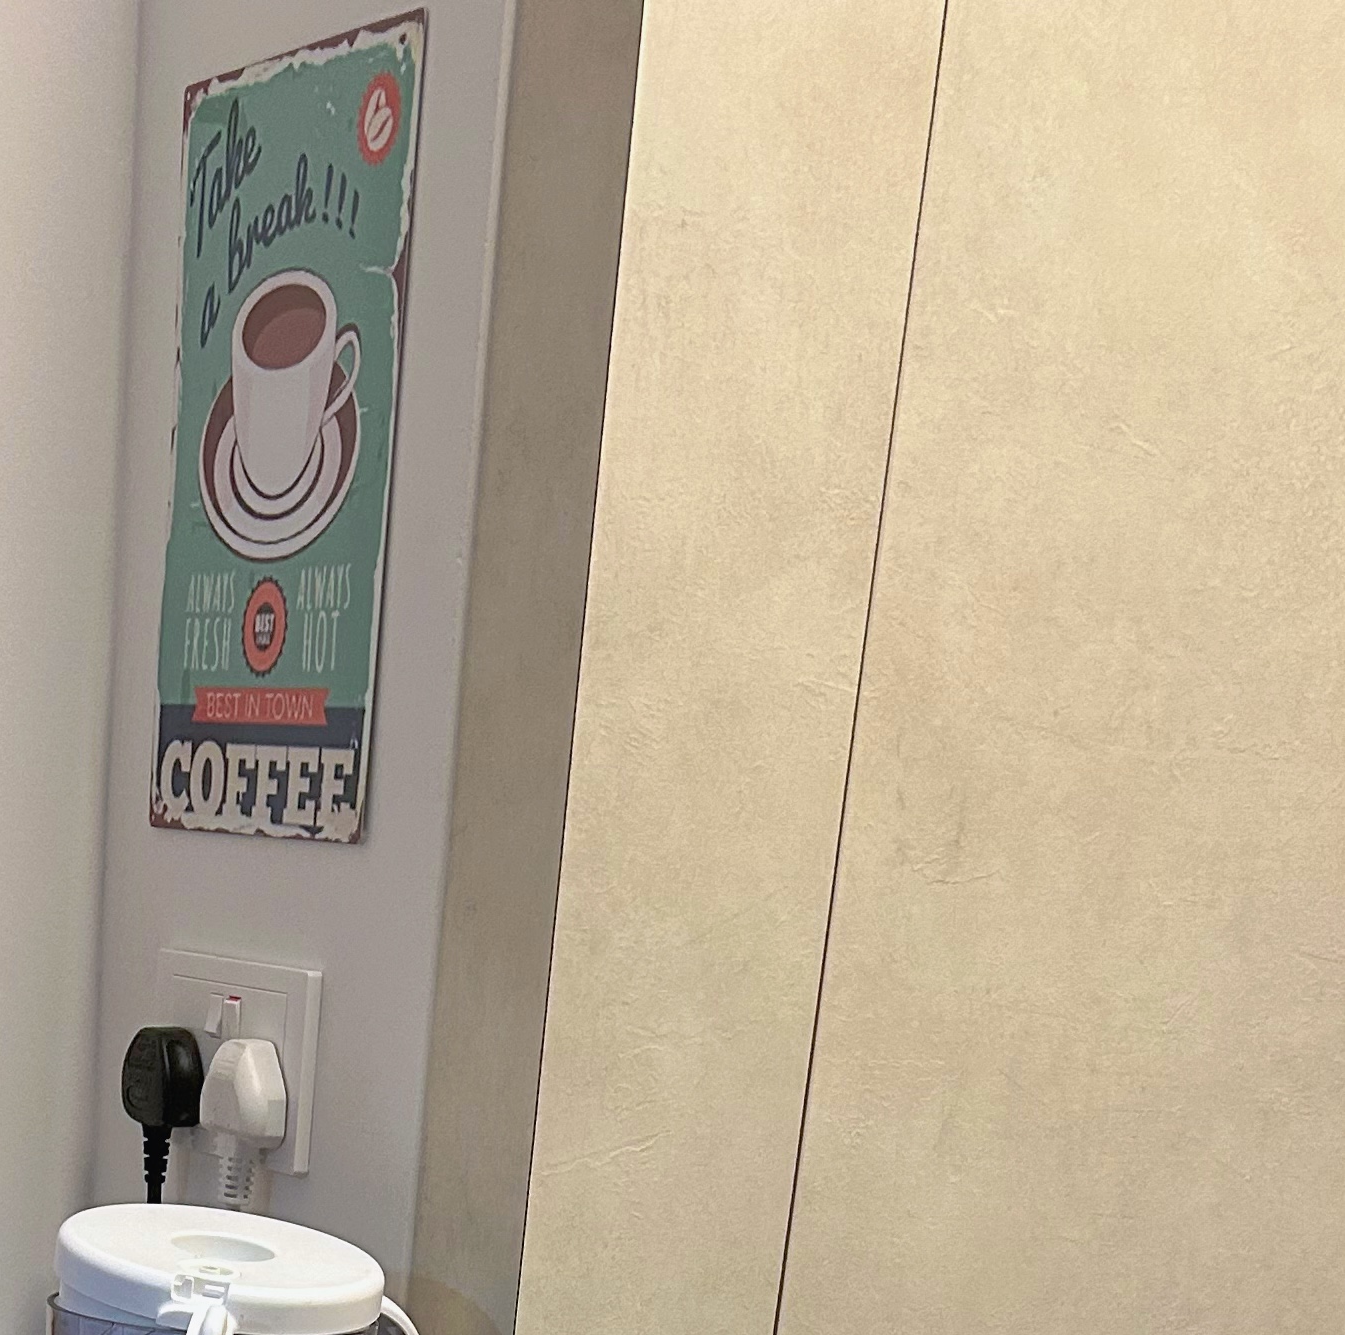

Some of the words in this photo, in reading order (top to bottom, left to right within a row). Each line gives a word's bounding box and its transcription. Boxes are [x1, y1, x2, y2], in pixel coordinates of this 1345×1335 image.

[190, 98, 262, 259] Take
[200, 282, 221, 349] a
[227, 152, 360, 294] break!!!
[186, 571, 235, 614] ALWAYS
[296, 563, 352, 610] ALWAYS
[183, 616, 233, 672] FRESH
[301, 610, 341, 673] HOT
[206, 692, 240, 719] BEST
[245, 692, 260, 719] IN
[265, 693, 314, 721] TOWN
[159, 739, 358, 831] COFFEE
